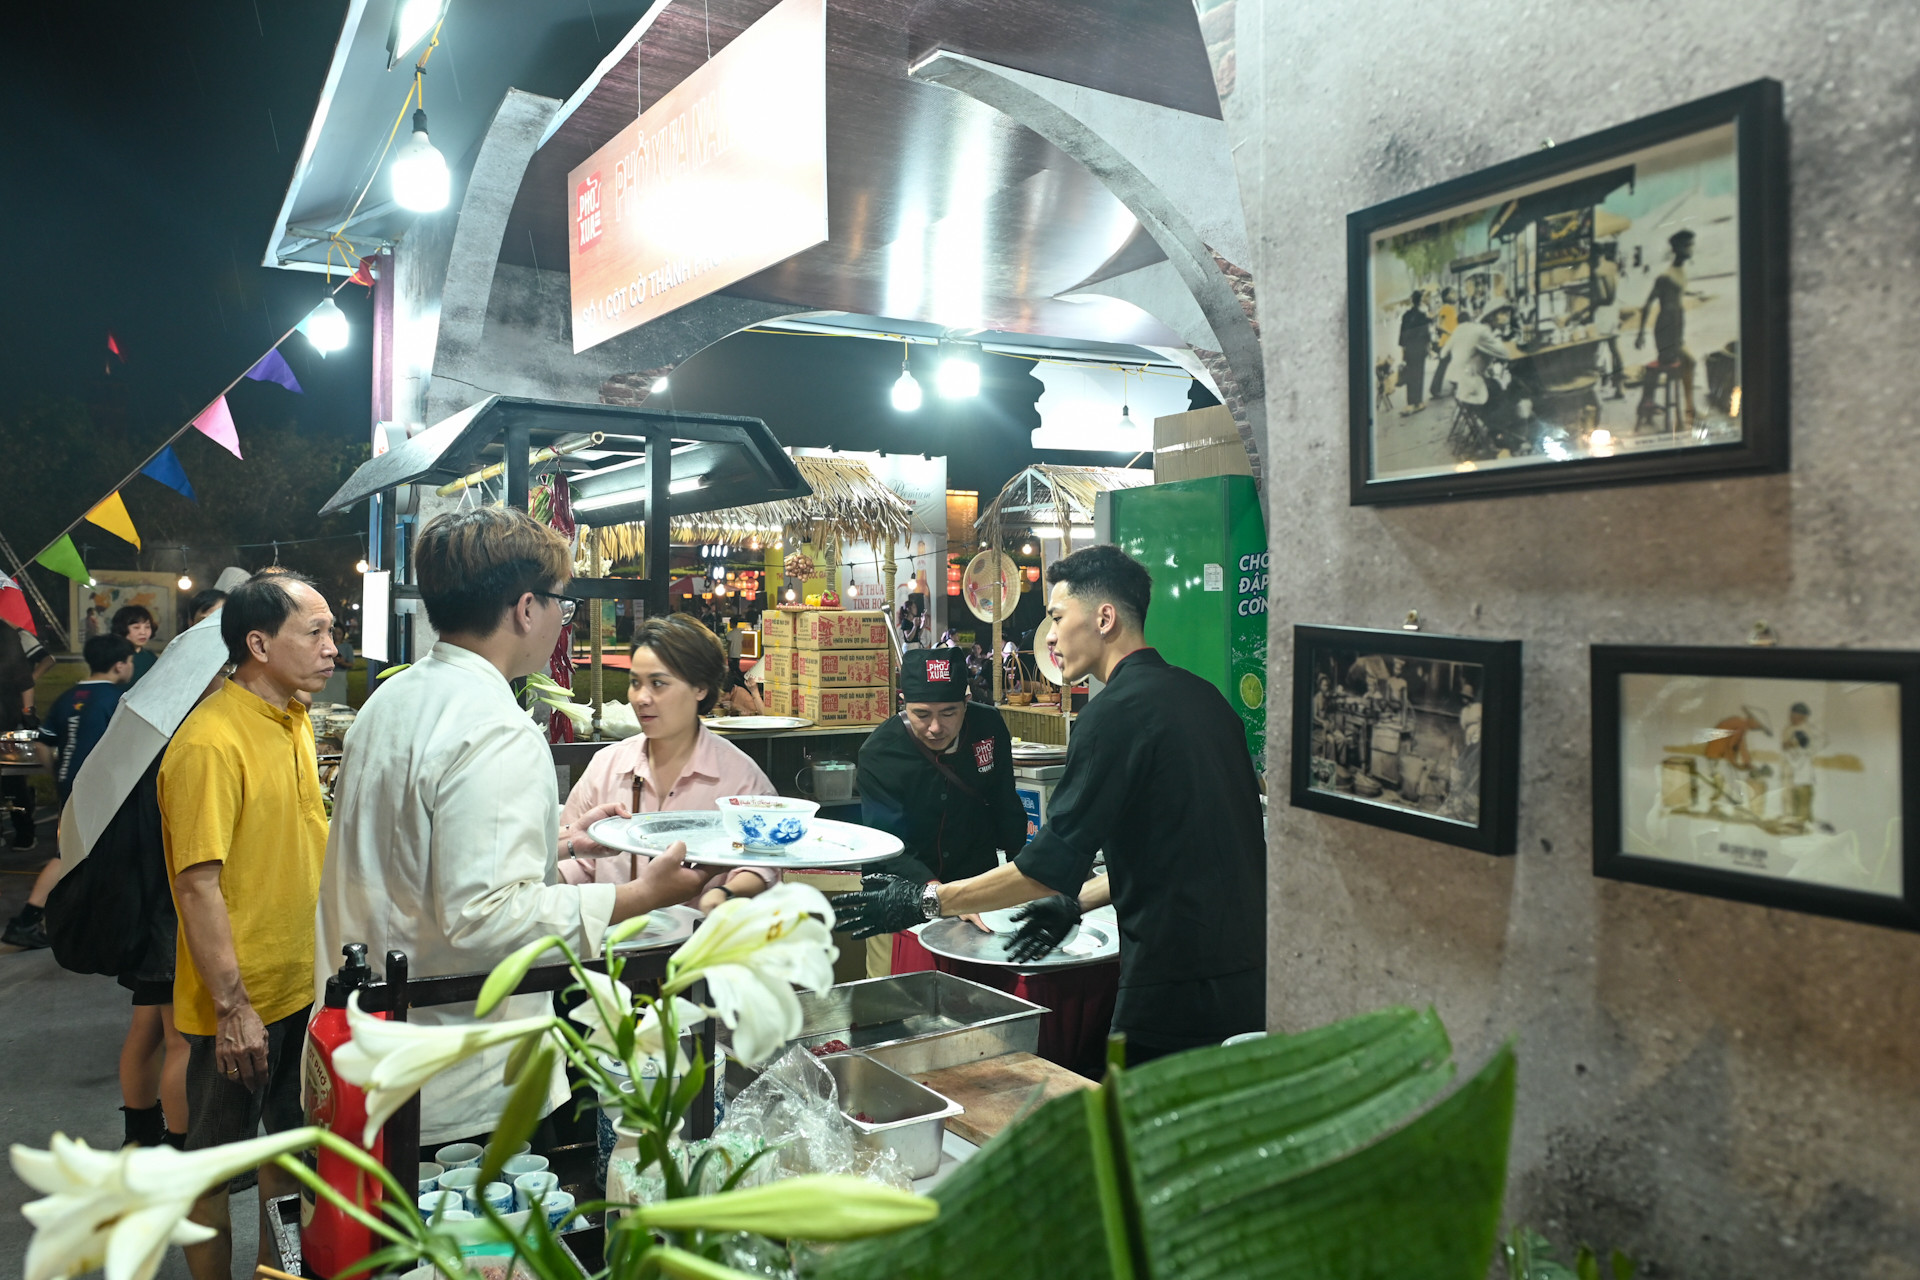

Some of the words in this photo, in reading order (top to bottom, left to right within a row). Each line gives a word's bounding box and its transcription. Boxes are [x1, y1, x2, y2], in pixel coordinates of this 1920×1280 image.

[606, 287, 628, 322] CỘT
[629, 271, 647, 308] CỜ
[648, 257, 691, 297] THÀNH
[887, 478, 932, 499] Premium
[1238, 571, 1270, 596] ĐẬP
[853, 598, 871, 611] TINH
